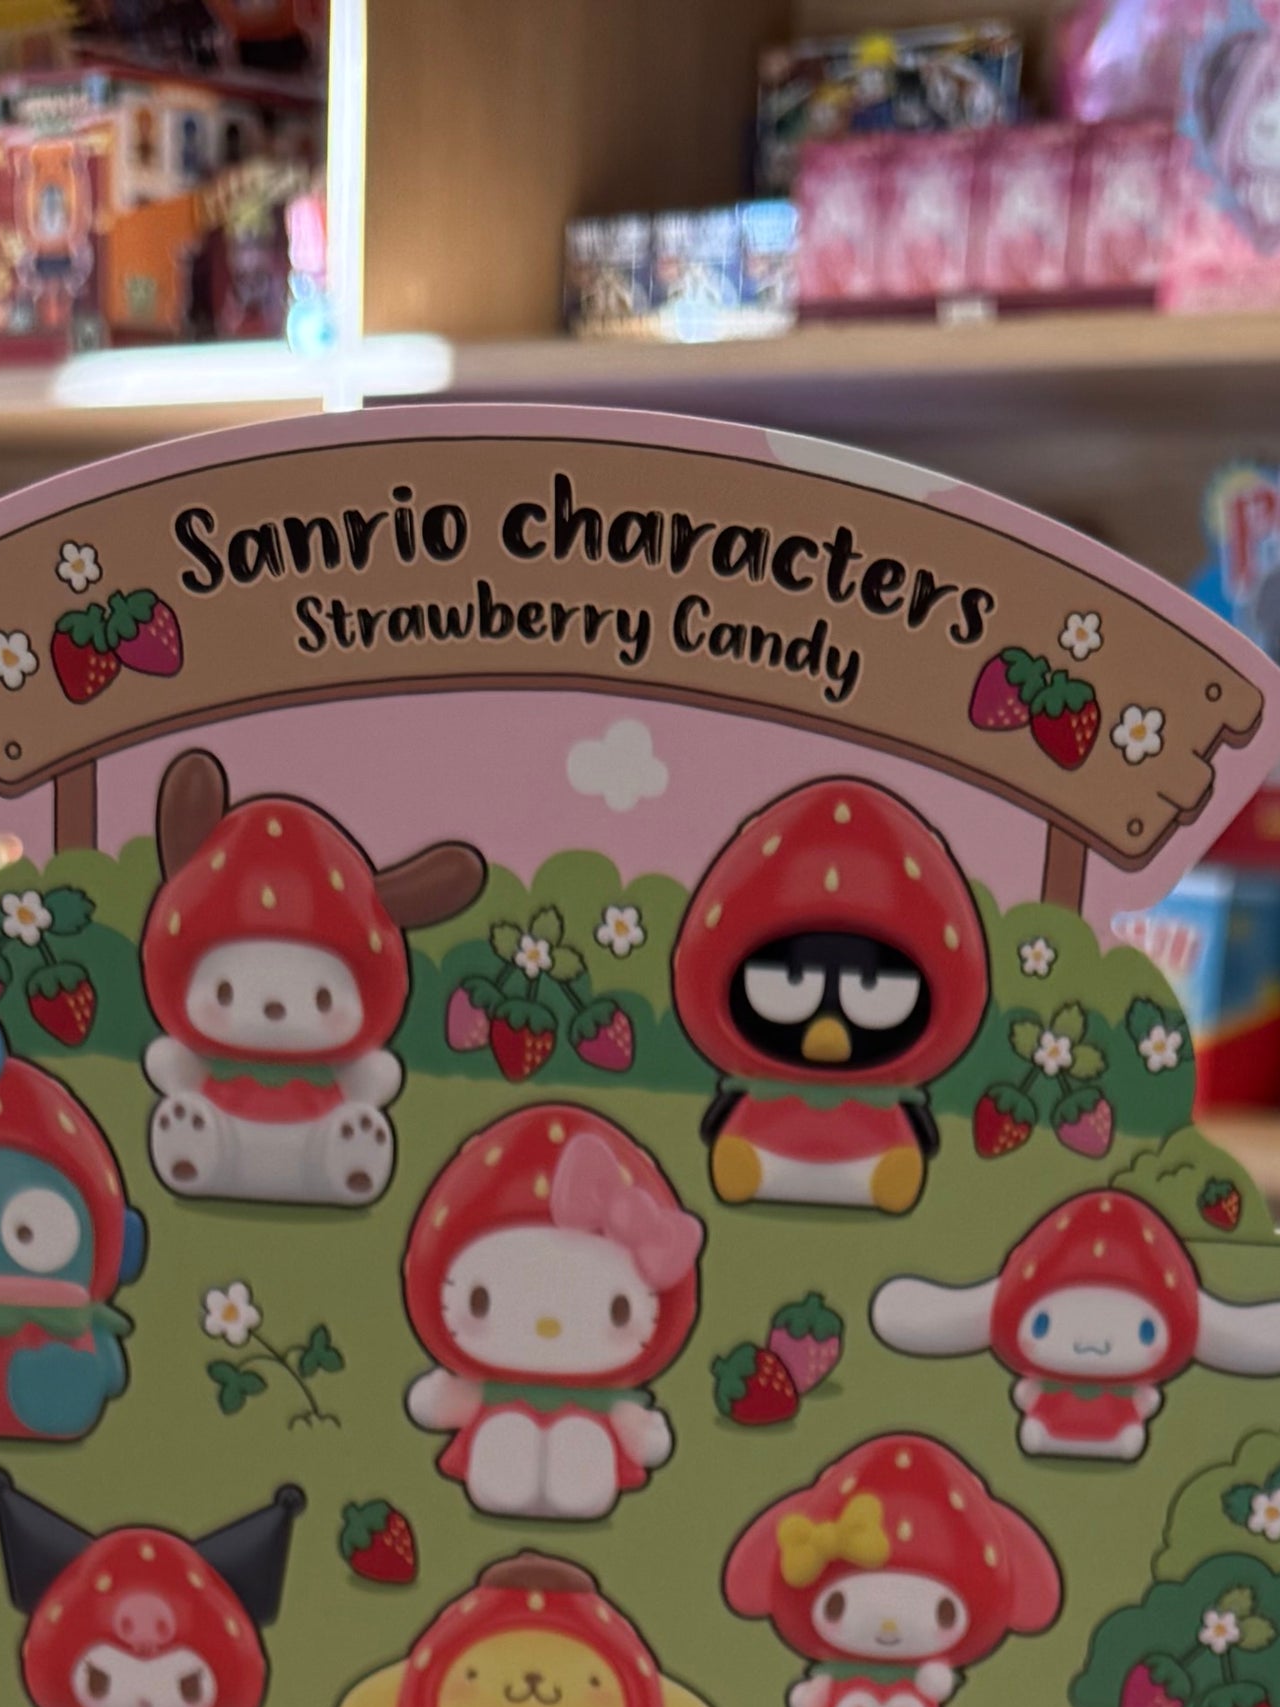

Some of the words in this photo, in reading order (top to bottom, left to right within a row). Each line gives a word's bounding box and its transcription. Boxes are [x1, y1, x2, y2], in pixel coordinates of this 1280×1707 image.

[174, 483, 468, 593] Sanrio
[503, 474, 995, 645] characters
[295, 580, 652, 665] Strawberry
[673, 593, 861, 702] Candy
